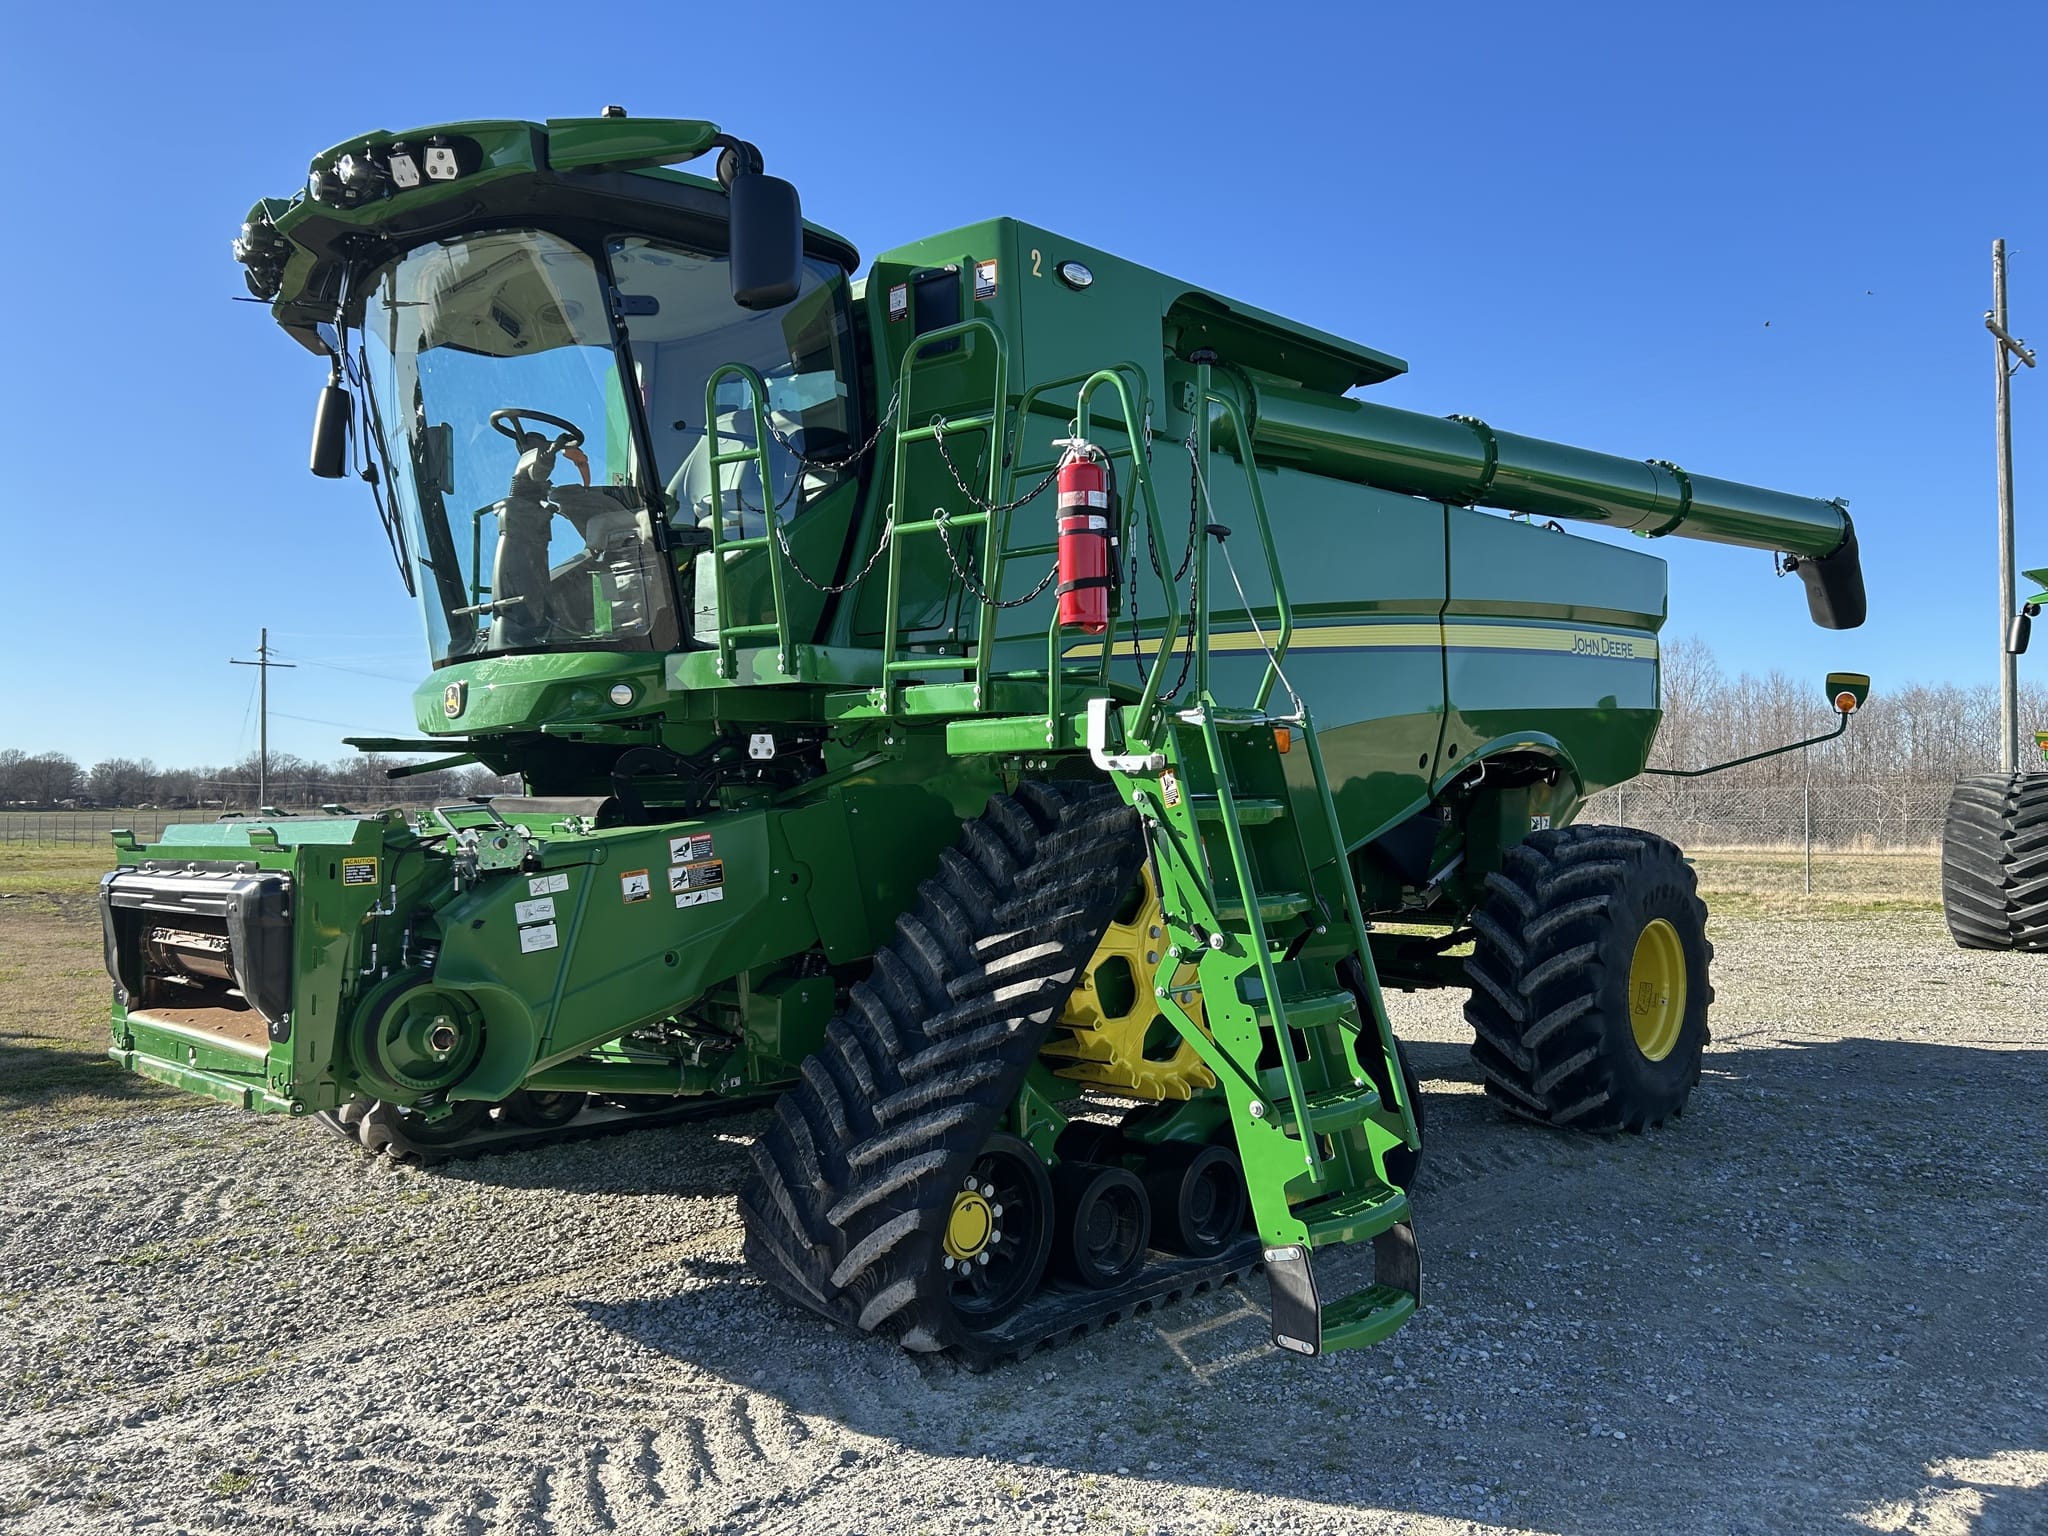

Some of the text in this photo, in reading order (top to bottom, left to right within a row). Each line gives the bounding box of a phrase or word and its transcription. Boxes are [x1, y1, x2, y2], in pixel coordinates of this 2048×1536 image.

[1031, 249, 1042, 278] 2
[1571, 634, 1634, 658] JOHN DEERE
